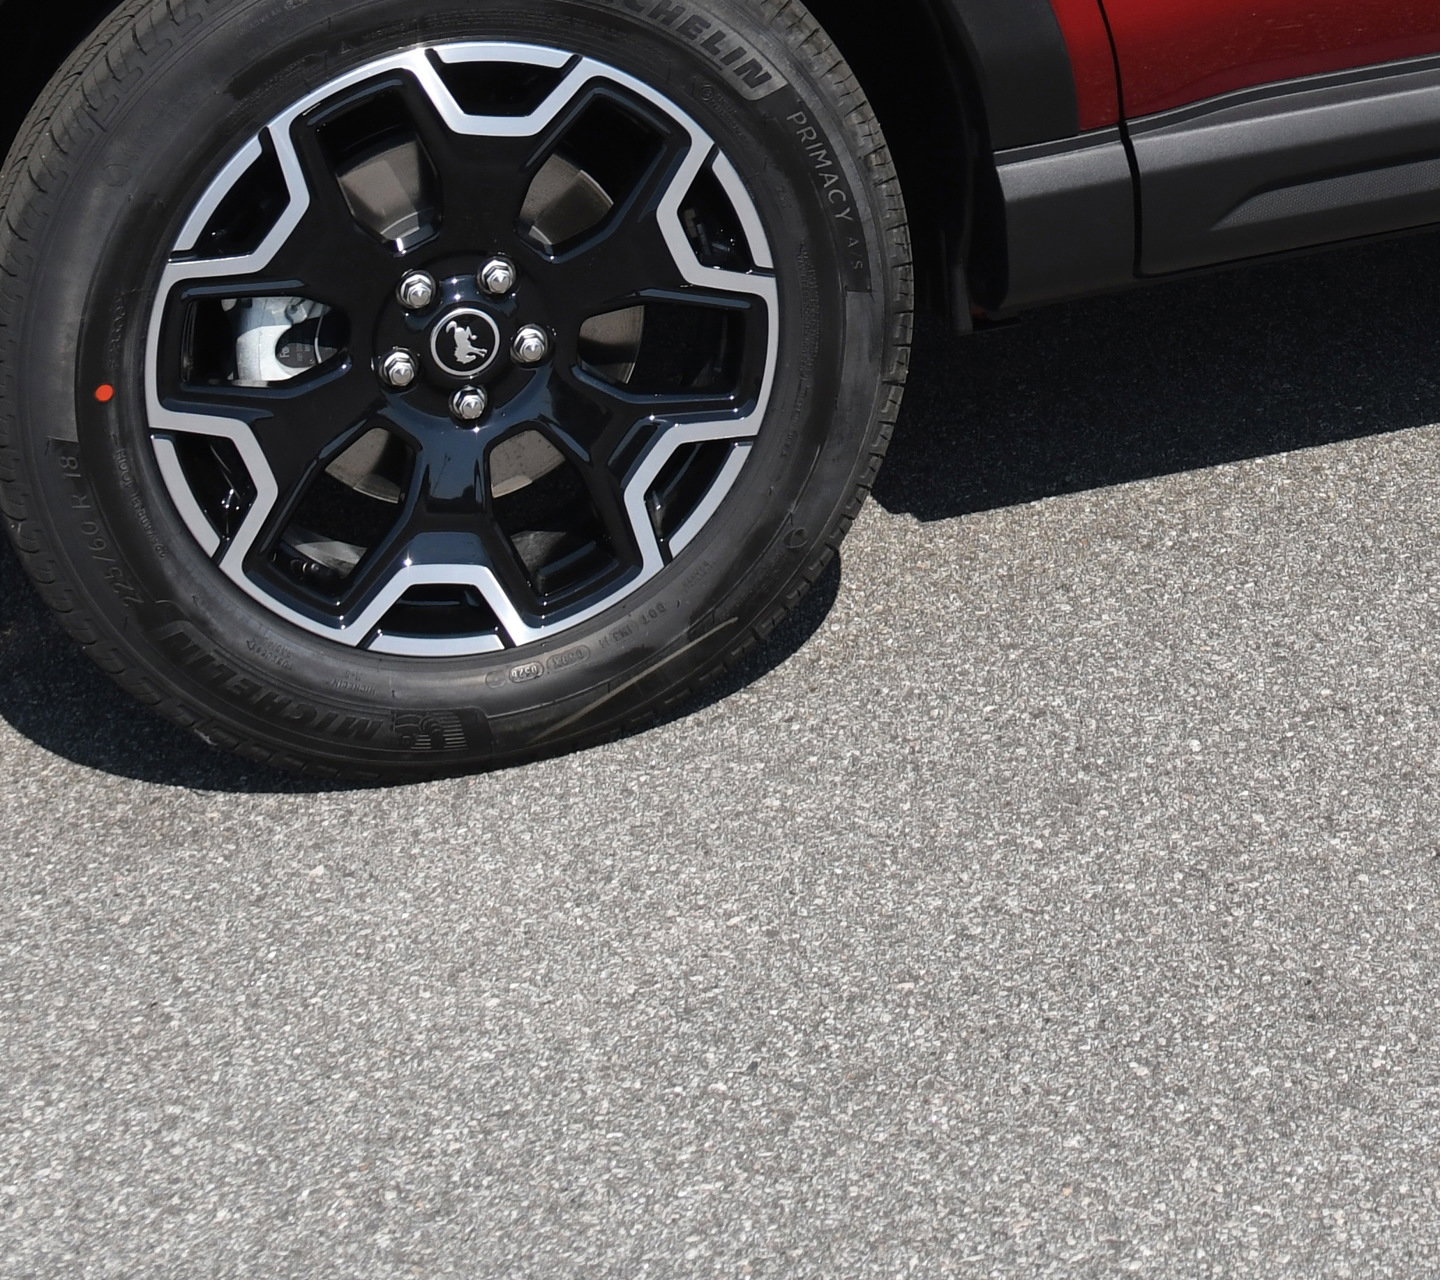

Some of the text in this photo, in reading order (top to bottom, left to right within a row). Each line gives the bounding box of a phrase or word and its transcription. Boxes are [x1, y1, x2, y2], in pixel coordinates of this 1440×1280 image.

[785, 110, 853, 223] PRIMACY
[60, 456, 145, 608] 225/60 R 18
[162, 631, 384, 739] MICHELIN
